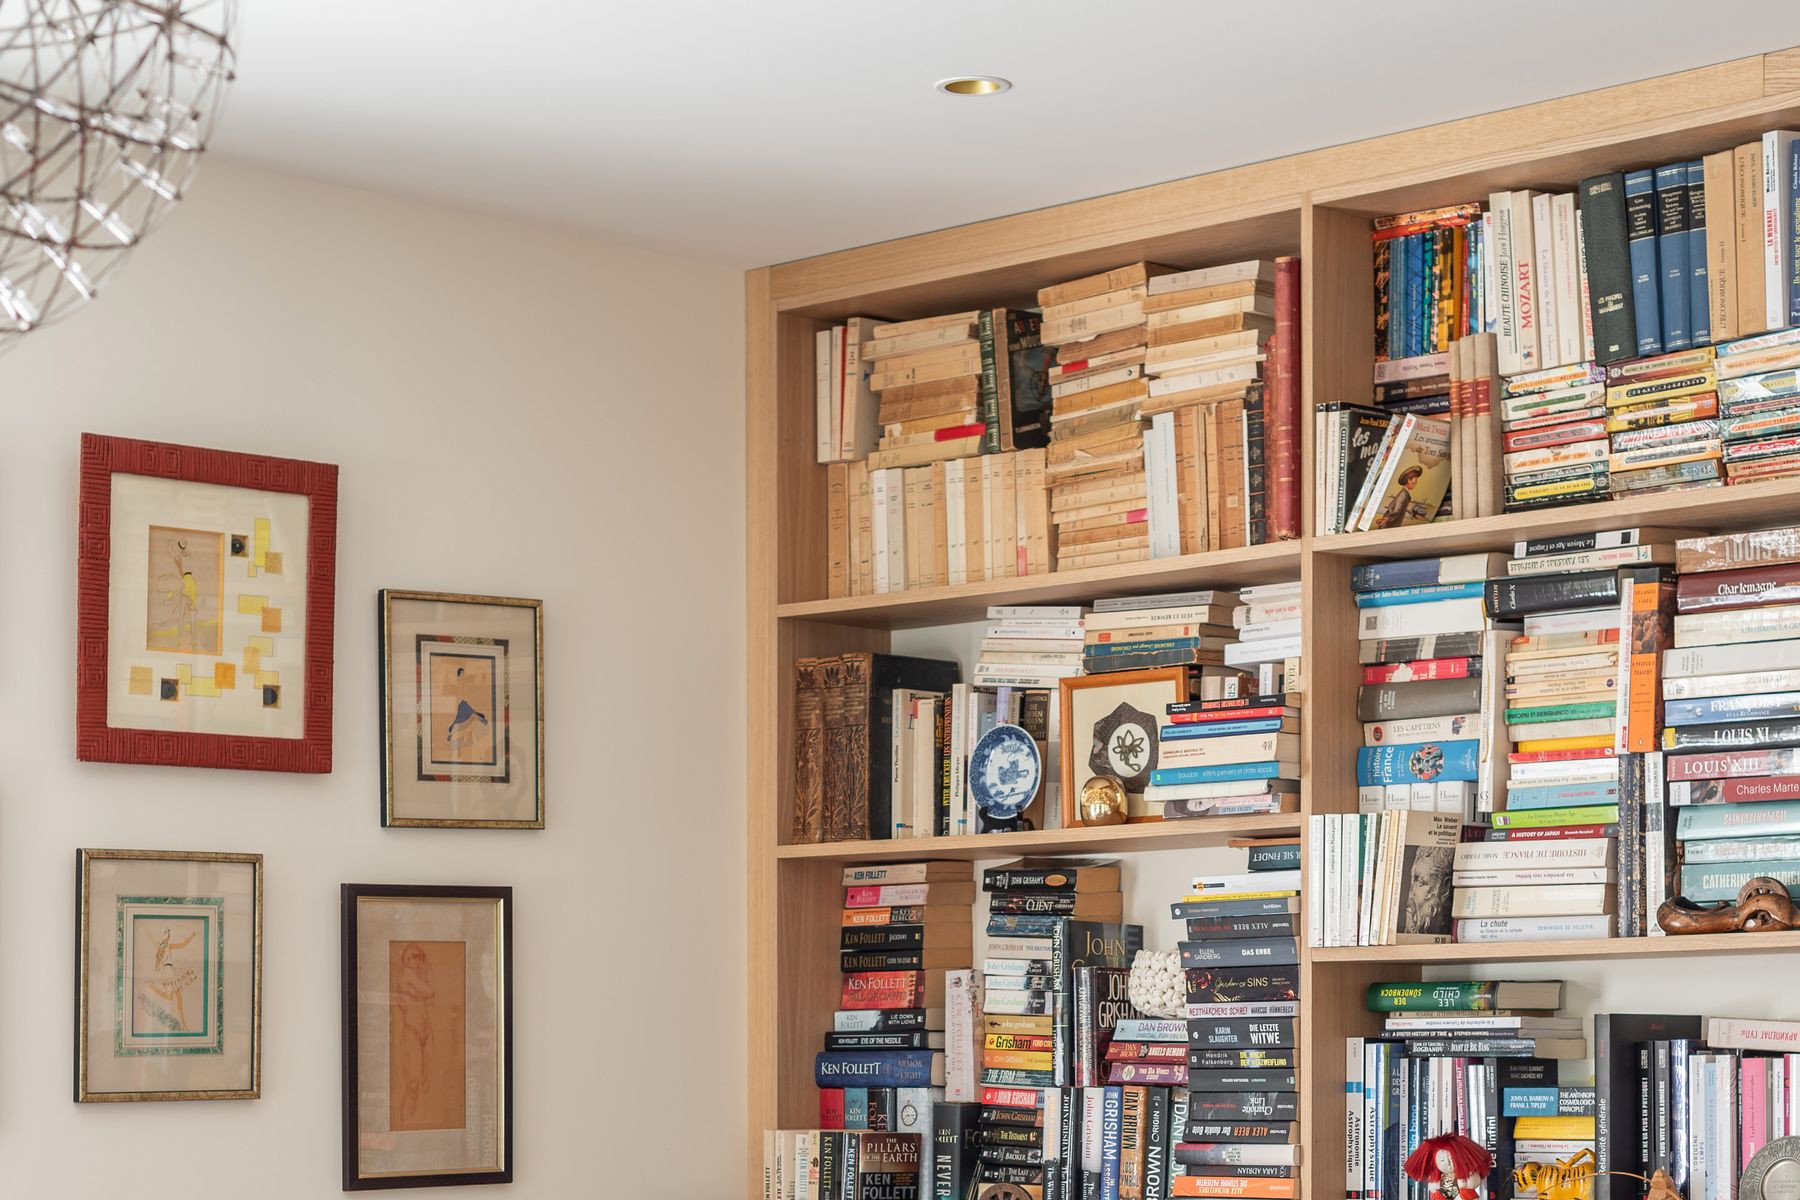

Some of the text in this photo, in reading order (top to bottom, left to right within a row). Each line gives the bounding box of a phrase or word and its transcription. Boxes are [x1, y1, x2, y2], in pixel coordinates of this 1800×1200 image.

[1767, 237, 1773, 246] LA
[1518, 260, 1532, 329] MOZART
[1417, 422, 1448, 435] Mark Twain
[1352, 428, 1370, 447] les
[1415, 433, 1424, 442] Les
[1425, 446, 1438, 456] Tom
[1529, 544, 1549, 552] l'argent
[1558, 542, 1569, 550] Age
[1570, 540, 1586, 548] Moyen
[1718, 581, 1777, 596] Charlemagne
[944, 697, 952, 744] ENTREPRENEURS
[1714, 727, 1770, 744] LOUIS XI
[1373, 747, 1383, 777] histoire
[1383, 746, 1394, 783] France
[1684, 758, 1760, 774] LOUIS XIII
[1252, 852, 1294, 862] SIE FINDET
[1502, 848, 1587, 860] HISTOIRE DE FRANCE
[1026, 900, 1054, 911] CLIENT
[1232, 923, 1250, 931] BEER
[1480, 919, 1508, 928] La chute
[1086, 931, 1126, 956] JOHN
[1052, 926, 1060, 990] JOHN GRISHAM
[848, 978, 907, 990] KEN FOLLETT
[1380, 988, 1422, 997] SÜNDENBOCK
[1394, 997, 1406, 1005] DER
[1438, 998, 1455, 1007] LEE
[1138, 1023, 1187, 1032] DAN BROWN
[1215, 1026, 1231, 1034] KARIN
[1249, 1023, 1279, 1032] DIE LETZTE
[1208, 1034, 1238, 1043] SLAUGHTER
[1250, 1032, 1280, 1044] WITWE
[821, 1062, 881, 1075] KEN FOLLETT
[1249, 1097, 1266, 1107] Link
[1241, 1106, 1273, 1116] Charlotte
[1122, 1091, 1139, 1150] DAN BROWN
[1151, 1110, 1160, 1142] ORIGIN
[1086, 1095, 1095, 1159] John Grisham
[1103, 1100, 1119, 1160] GRISHAM
[1192, 1126, 1268, 1136] ALEX BEER Der dunkle Bote
[1598, 1098, 1608, 1176] Relativité générale
[867, 1143, 916, 1153] PILLARS
[847, 1164, 855, 1200] FOLLETT
[865, 1173, 891, 1185] KEN
[936, 1155, 952, 1197] NEVER
[862, 1186, 916, 1200] FOLLETT
